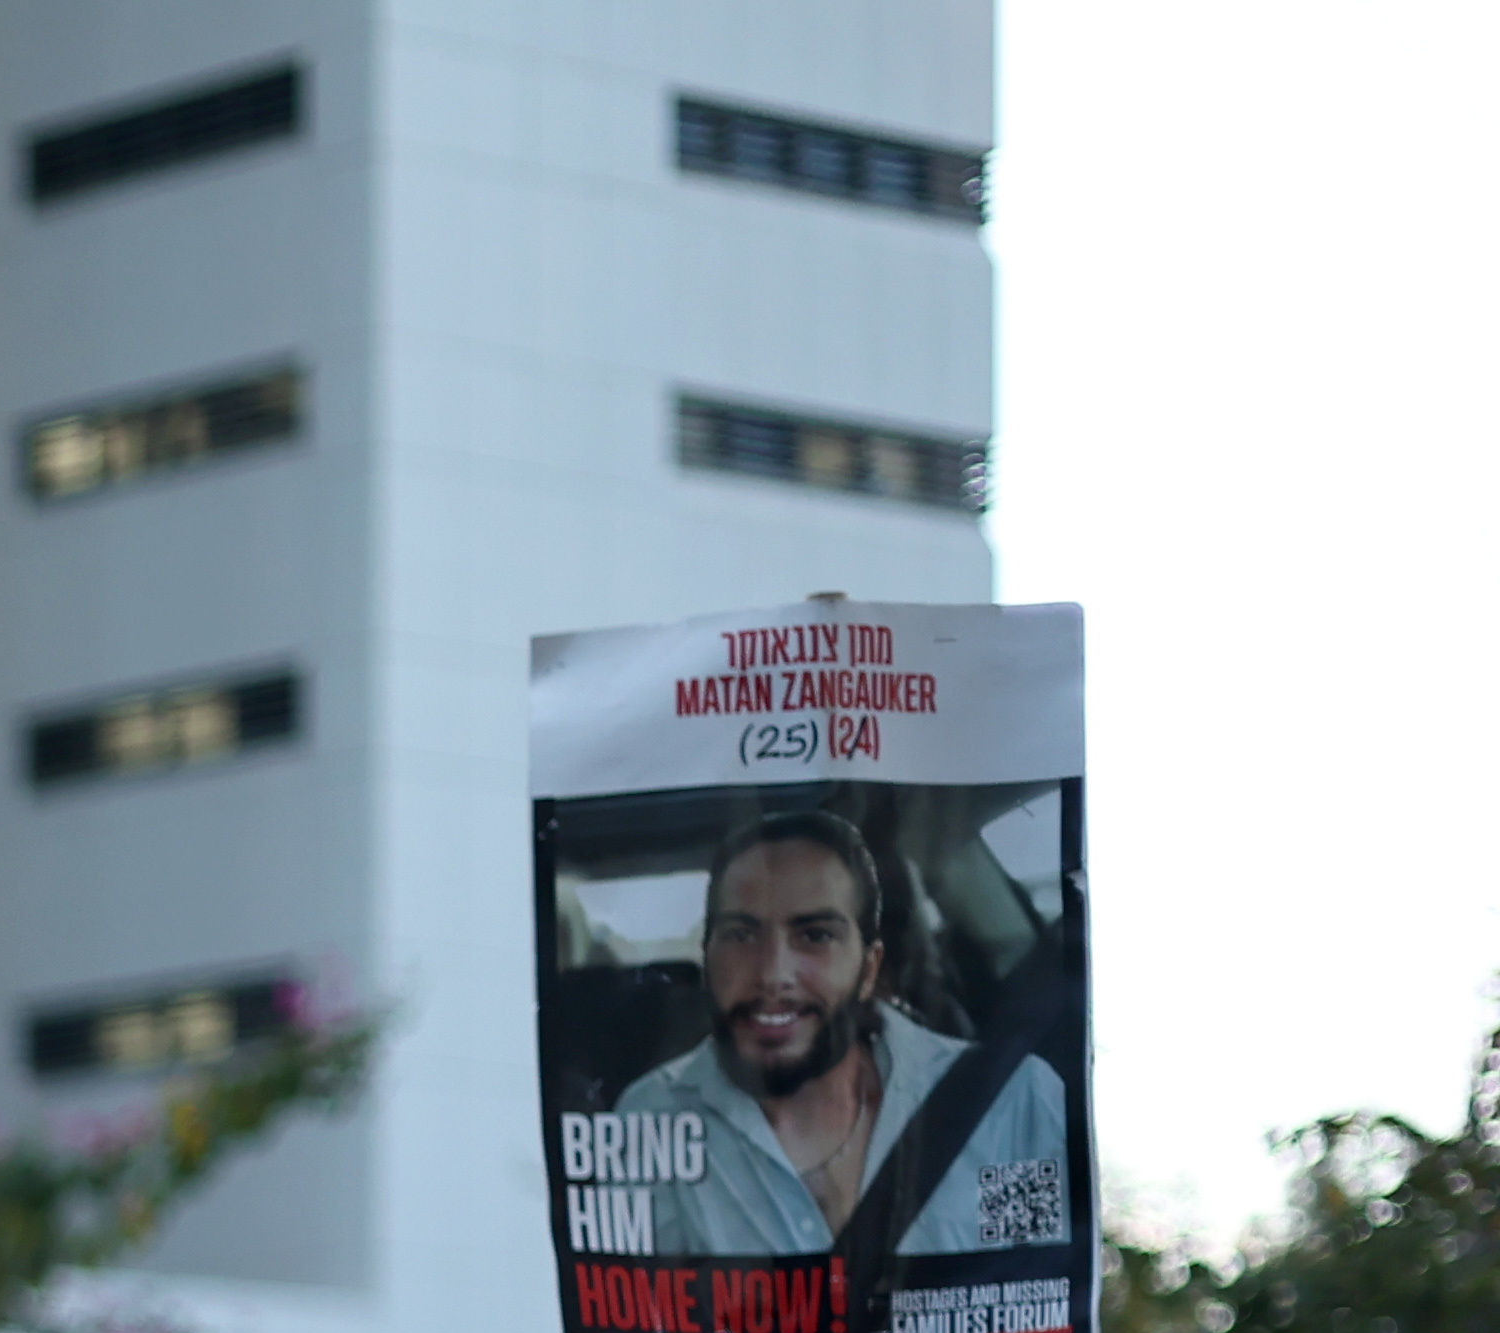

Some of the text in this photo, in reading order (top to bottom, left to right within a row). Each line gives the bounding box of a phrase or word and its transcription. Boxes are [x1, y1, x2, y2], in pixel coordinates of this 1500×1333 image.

[721, 624, 893, 671] מתן צנגאוקר
[676, 670, 936, 717] MATAN ZANGAUKER
[739, 720, 818, 767] (25)
[561, 1111, 705, 1183] BRING
[567, 1184, 655, 1256] HIM
[575, 1262, 701, 1333] HOME
[891, 1276, 1070, 1312] HOSTAGES AND MISSING
